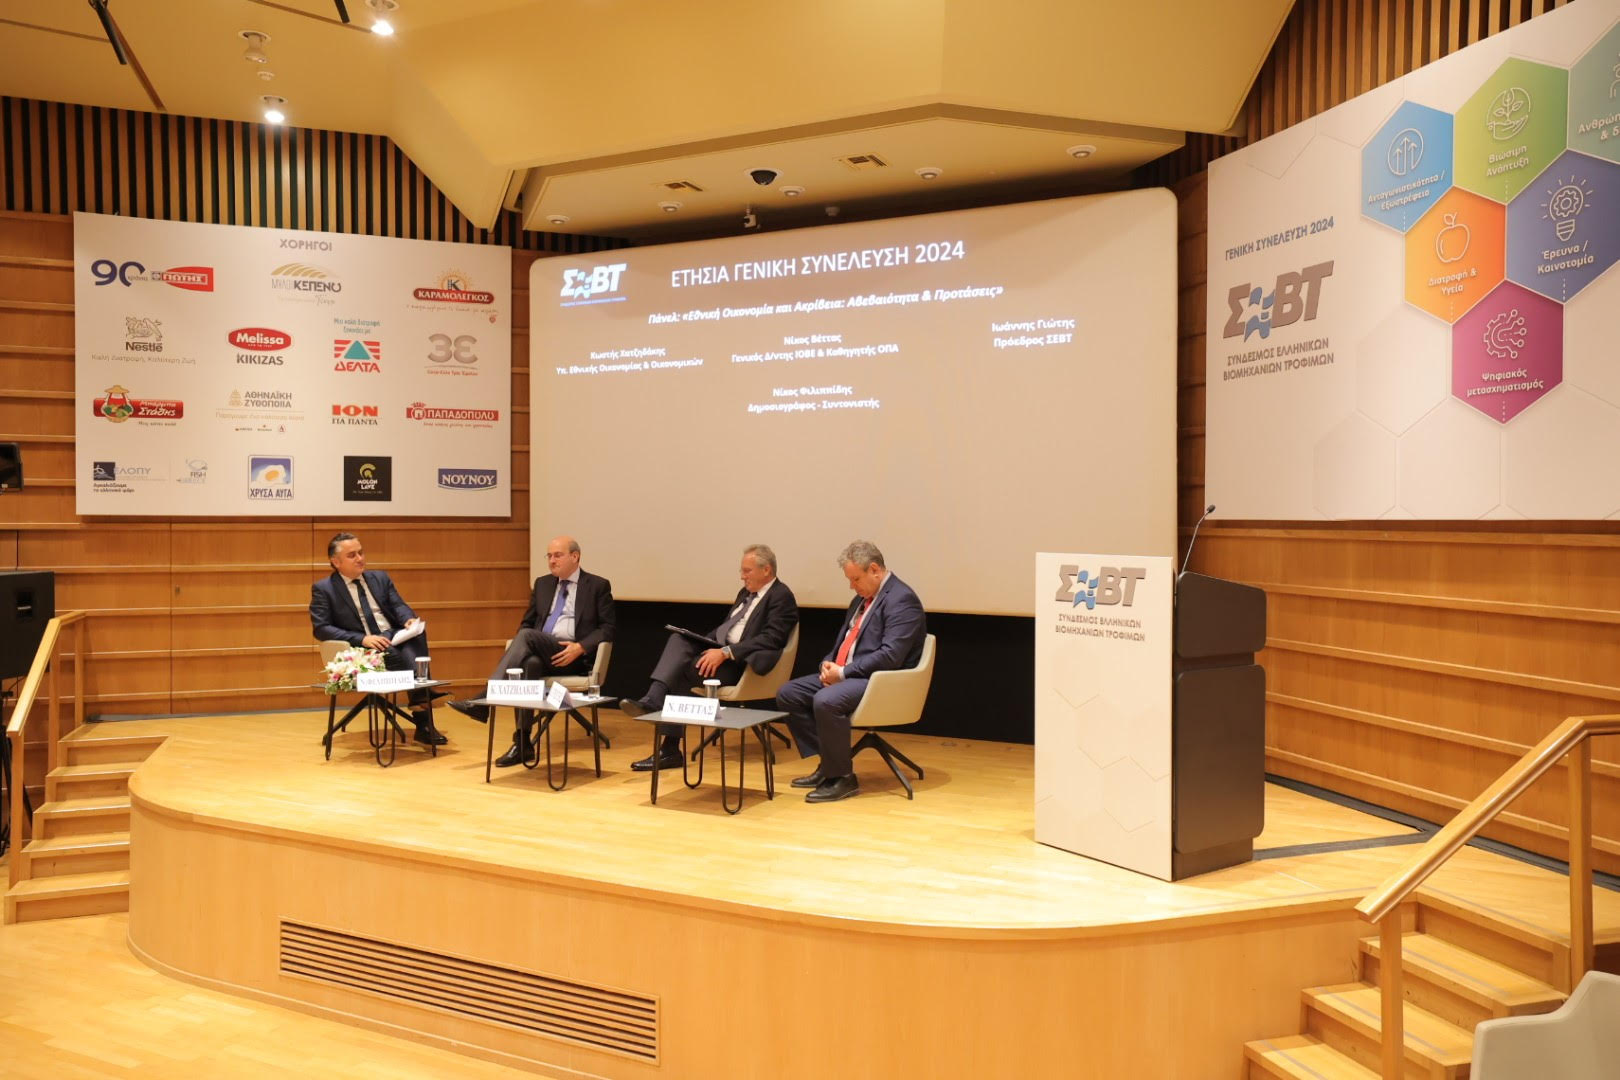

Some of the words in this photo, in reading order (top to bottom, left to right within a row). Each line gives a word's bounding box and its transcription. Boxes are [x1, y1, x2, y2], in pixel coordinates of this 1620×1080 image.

[1600, 129, 1609, 141] &
[1488, 145, 1527, 164] Βιώσιμη
[1486, 157, 1529, 177] Ανάπτυξη
[279, 238, 333, 252] ΧΟΡΗΓΟΙ
[1225, 242, 1254, 261] ΓΕΝΙΚΗ
[1256, 225, 1307, 251] ΣΥΝΕΛΕΥΣΗ
[1310, 216, 1334, 234] 2024
[1541, 244, 1580, 261] Έρευνα
[671, 265, 729, 288] ΕΤΗΣΙΑ
[734, 258, 796, 281] ΓΕΝΙΚΗ
[801, 246, 909, 275] ΣΥΝΕΛΕΥΣΗ
[915, 240, 965, 264] 2024
[1537, 254, 1594, 275] Καινοτομία
[1428, 270, 1468, 286] Διατροφή
[418, 290, 490, 302] ΚΑΡΑΜΟΛΕΓΚΟΣ
[1441, 283, 1464, 296] Υγεία
[722, 303, 774, 319] Οικονομία
[775, 305, 792, 314] και
[794, 298, 845, 314] Ακρίβεια:
[847, 292, 920, 308] Αβεβαιότητα
[921, 290, 931, 301] &
[992, 319, 1035, 332] Ιωάννης
[1037, 317, 1076, 329] Γιώτης
[237, 332, 284, 345] Melissa
[784, 335, 809, 345] Νίκος
[811, 333, 842, 344] Βέττας
[994, 335, 1044, 349] Πρόεδρος
[1046, 333, 1073, 344] ΣΕΒΤ
[236, 353, 284, 365] KIKIZAS
[590, 349, 619, 360] Κωστής
[620, 347, 666, 358] Χατζηδάκης
[731, 352, 763, 363] Γενικός
[795, 349, 815, 359] ΙΟΒΕ
[817, 348, 825, 357] &
[826, 345, 877, 358] Καθηγητής
[877, 343, 899, 354] ΟΠΑ
[1228, 348, 1275, 366] ΣΥΝΔΕΣΜΟΣ
[1276, 337, 1329, 357] ΕΛΛΗΝΙΚΩΝ
[334, 361, 380, 373] ΔΕΛΤΑ
[569, 364, 598, 375] Εθνικής
[599, 361, 642, 373] Οικονομίας
[643, 361, 649, 369] &
[651, 357, 704, 370] Οικονομικών
[1223, 361, 1282, 381] ΒΙΟΜΗΧΑΝΙΩΝ
[1284, 353, 1334, 371] ΤΡΟΦΙΜΩΝ
[1482, 367, 1528, 381] Ψηφιακός
[244, 391, 292, 400] ΑΘΗΝΑΪΚΗ
[773, 386, 798, 397] Νίκος
[800, 384, 853, 396] Φιλιππίδης
[1467, 379, 1544, 397] μετασχηματισμός
[748, 400, 816, 414] Δημοσιογράφος
[822, 398, 880, 409] Συντονιστής
[348, 418, 378, 426] ΠΑΝΤΑ
[250, 487, 273, 498] ΧΡΥΣΑ
[275, 487, 293, 499] ΑΥΓΑ
[1058, 613, 1098, 625] ΣΥΝΔΕΣΜΟΣ
[1099, 617, 1141, 629] ΕΛΛΗΝΙΚΩΝ
[1055, 625, 1104, 638] ΒΙΟΜΗΧΑΝΙΩΝ
[1105, 629, 1145, 641] ΤΡΟΦΙΜΩΝ
